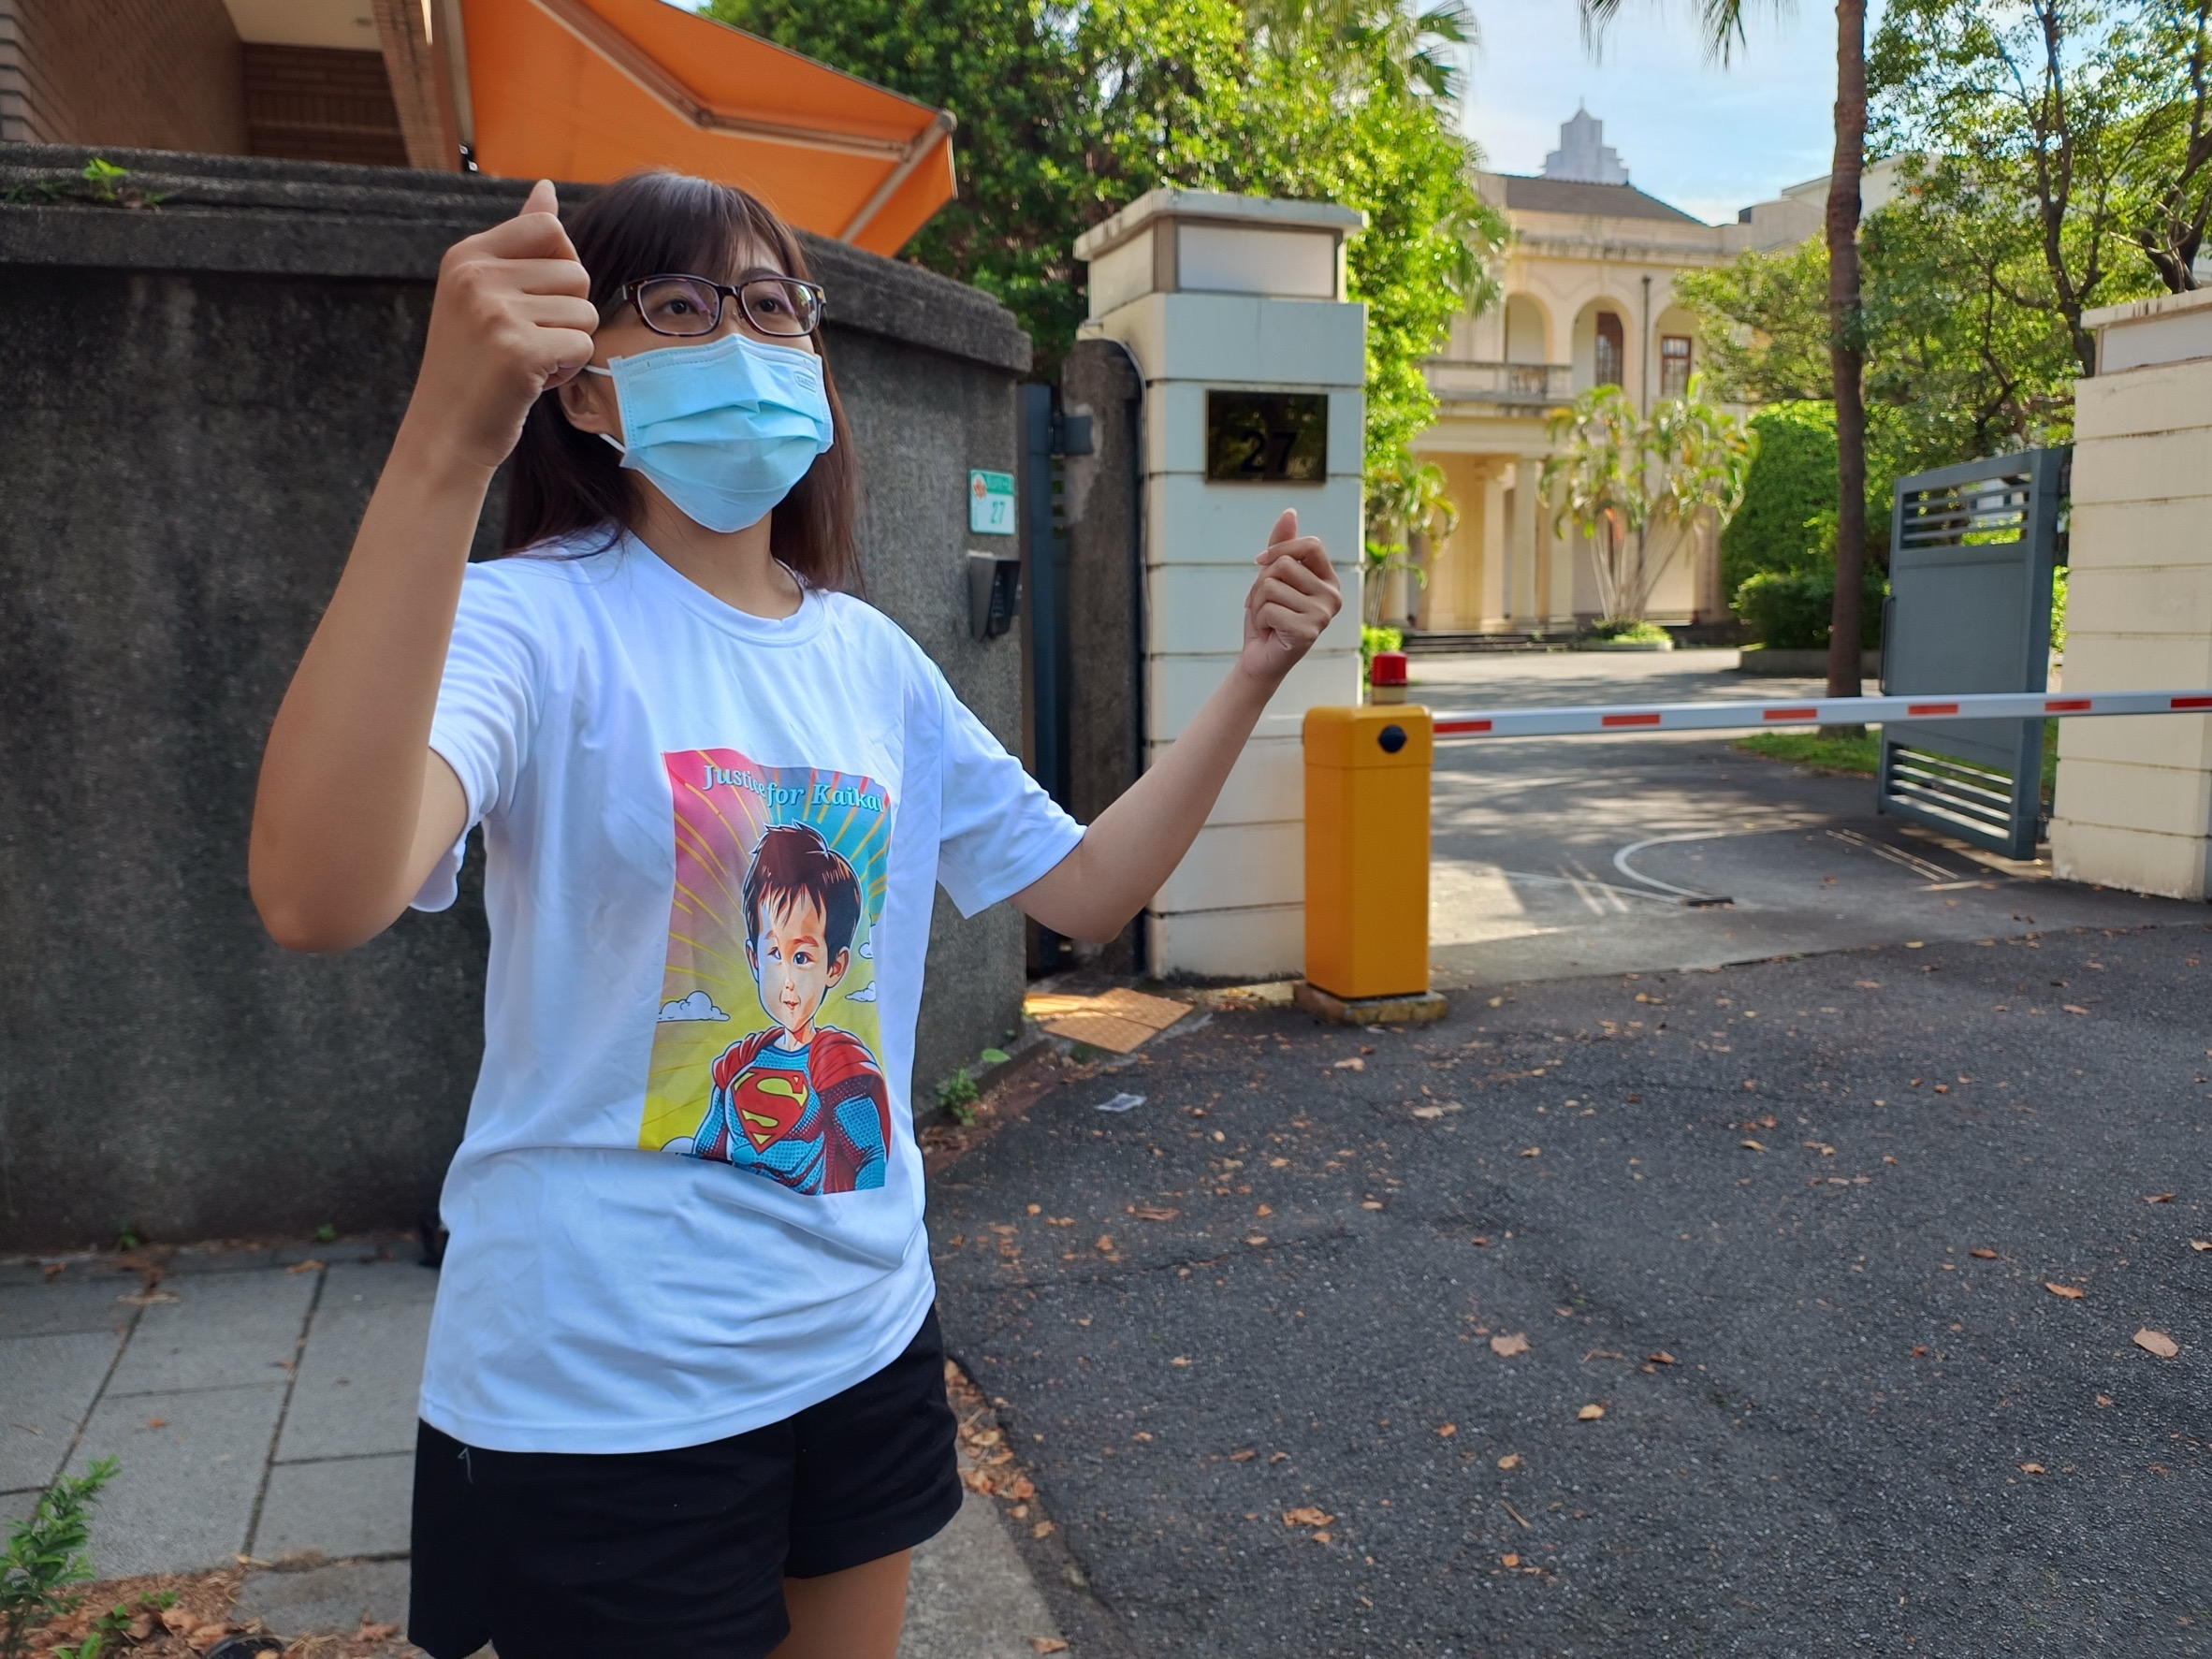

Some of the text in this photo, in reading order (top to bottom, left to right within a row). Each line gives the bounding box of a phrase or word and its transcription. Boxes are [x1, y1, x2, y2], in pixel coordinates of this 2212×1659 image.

[1241, 429, 1298, 473] 27
[989, 501, 1006, 524] 27
[703, 764, 885, 813] Justice for Kaikai
